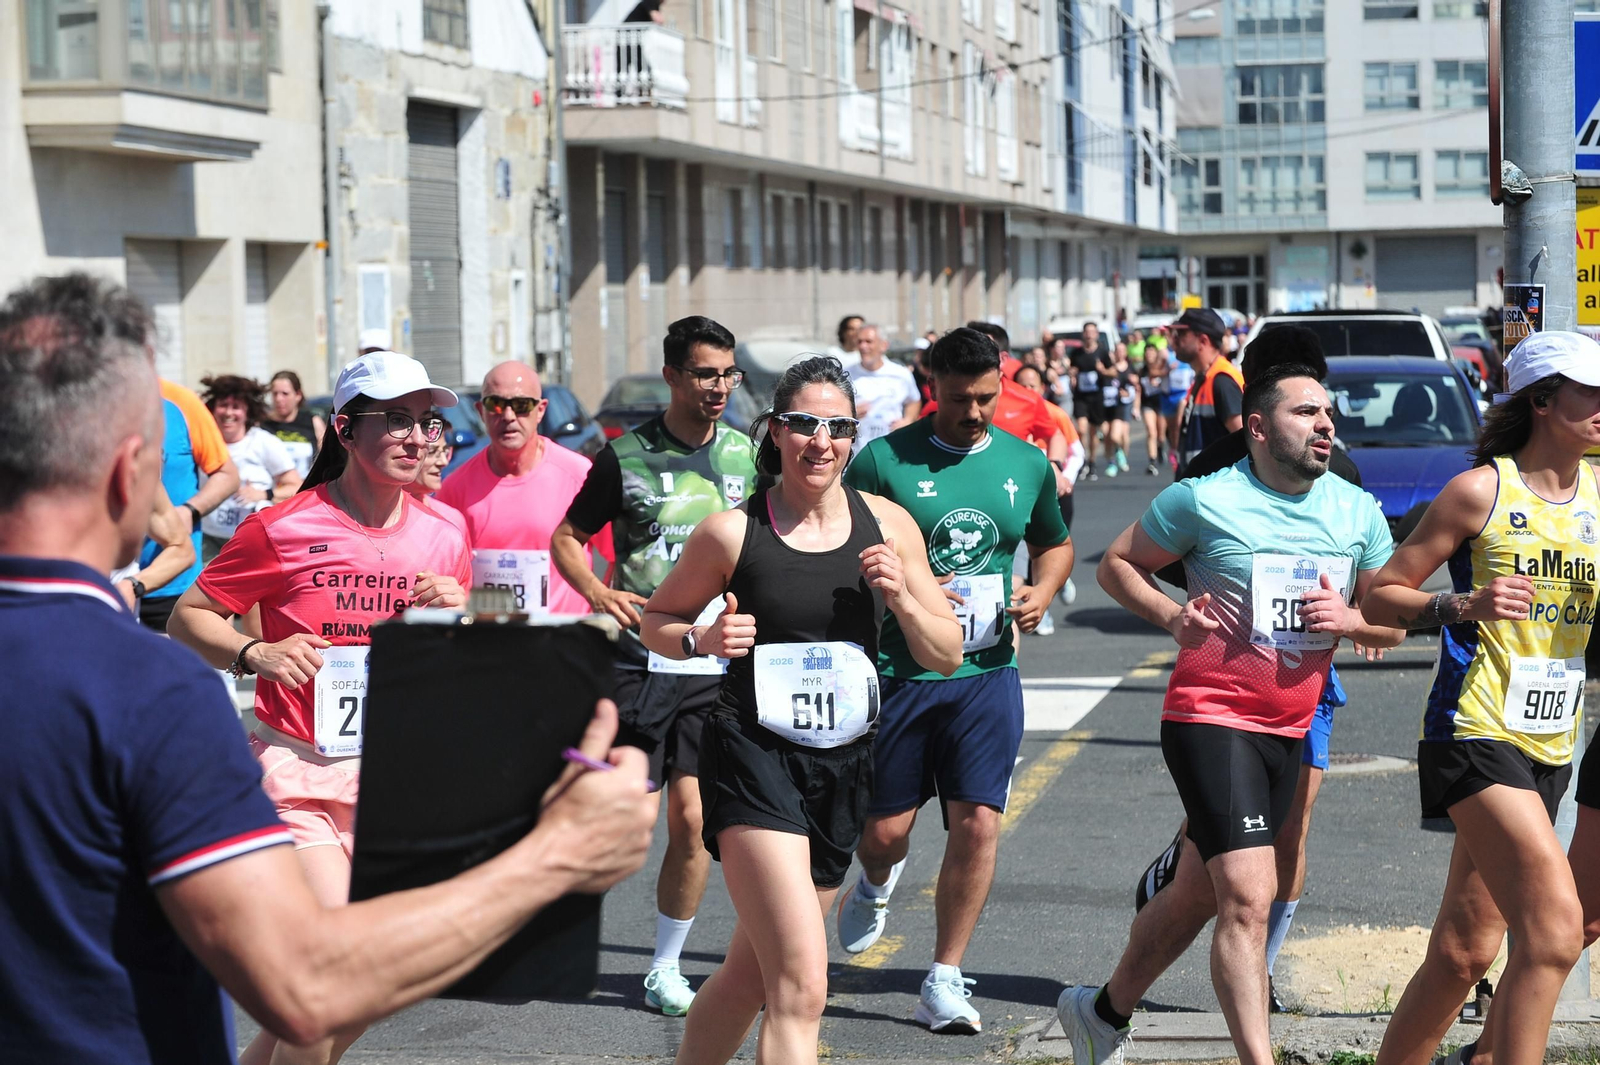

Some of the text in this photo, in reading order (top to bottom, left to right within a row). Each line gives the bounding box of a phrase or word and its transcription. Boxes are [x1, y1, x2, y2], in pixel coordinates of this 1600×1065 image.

[660, 472, 675, 493] 1
[944, 511, 990, 530] OURENSE
[1265, 566, 1286, 574] 2026
[312, 570, 407, 590] Carreira
[1284, 584, 1314, 594] GOMEZ
[1533, 583, 1556, 591] IENTA
[1557, 584, 1563, 592] A
[1575, 586, 1595, 594] MESA
[336, 591, 415, 613] Muller
[330, 660, 355, 668] 2026
[769, 657, 794, 666] 2026
[1518, 663, 1540, 672] 2026
[331, 678, 366, 690] SOFÍA
[802, 676, 823, 687] MYR
[1523, 689, 1567, 720] 908
[339, 696, 368, 736] 2
[791, 692, 835, 731] 611
